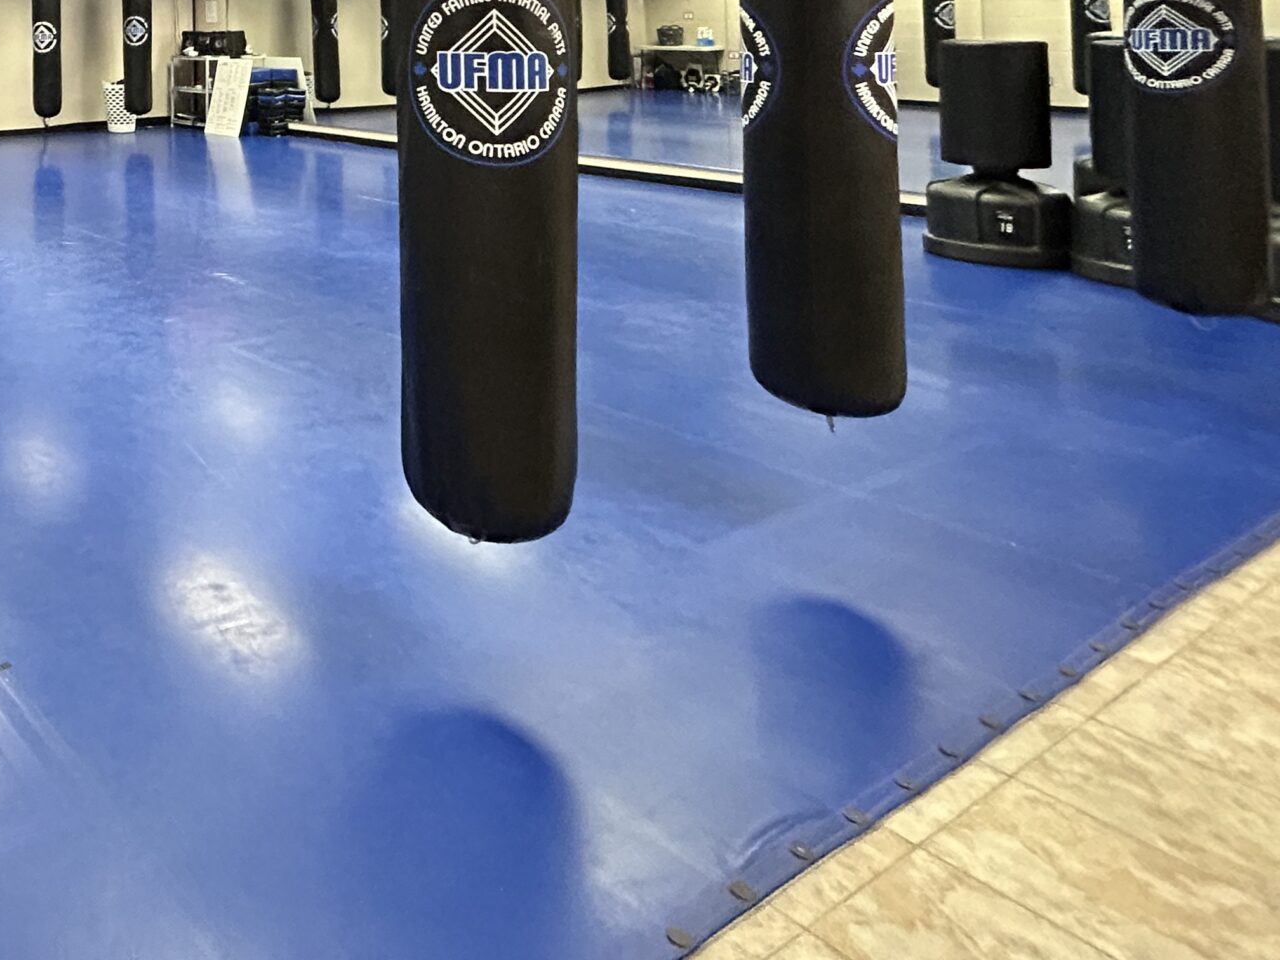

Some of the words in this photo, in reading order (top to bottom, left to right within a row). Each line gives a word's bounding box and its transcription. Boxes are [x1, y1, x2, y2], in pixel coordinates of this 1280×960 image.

[416, 12, 443, 55] UNITED
[547, 22, 566, 56] ARTS
[753, 31, 771, 57] ARTS
[854, 19, 880, 57] UNITED
[1131, 27, 1213, 52] UFMA
[436, 51, 549, 93] UFMA
[748, 81, 771, 119] CANADA
[416, 85, 466, 149] HAMILTON
[468, 135, 539, 158] ONTARIO
[539, 87, 567, 139] CANADA
